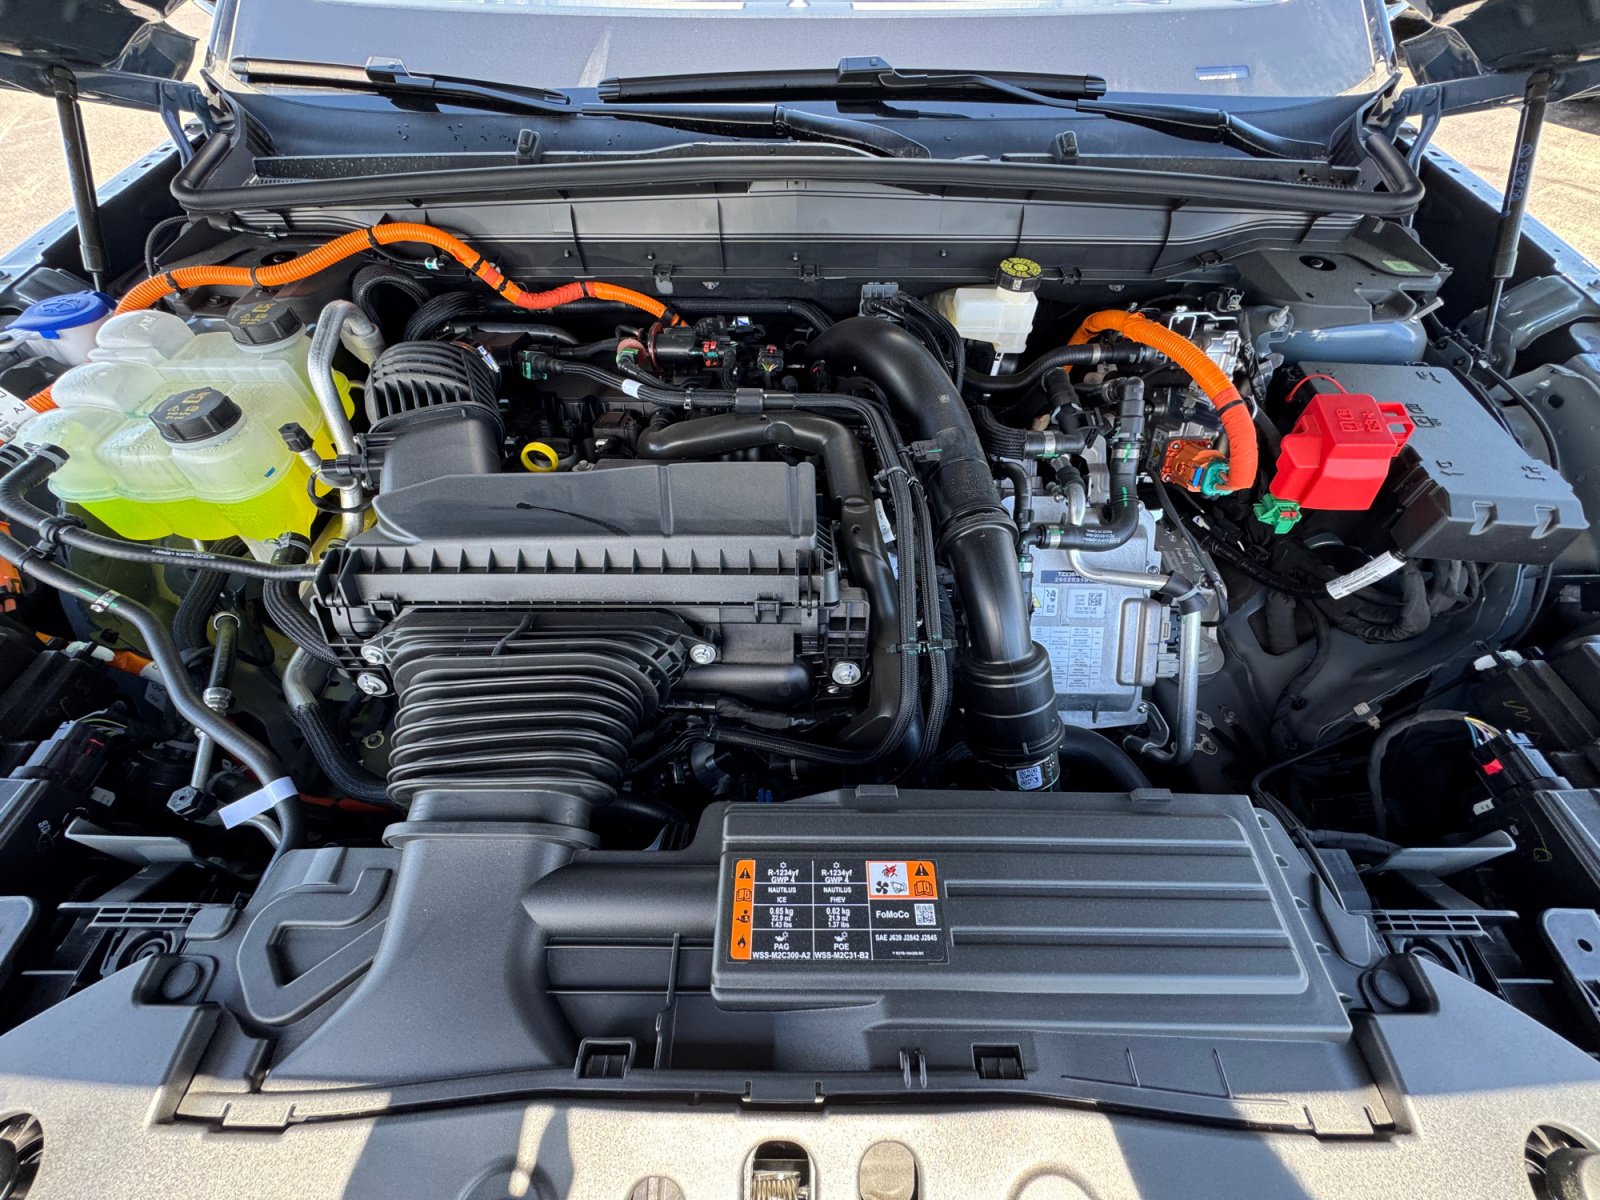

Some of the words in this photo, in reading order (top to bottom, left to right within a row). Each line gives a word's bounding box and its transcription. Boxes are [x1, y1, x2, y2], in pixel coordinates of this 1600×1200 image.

[767, 869, 799, 878] R-1234yf
[821, 869, 853, 878] R-1234yf
[767, 886, 797, 894] NAUTILUS
[823, 886, 852, 894] NAUTILUS
[769, 907, 784, 915] 0.65
[785, 907, 794, 917] kg
[826, 907, 840, 915] 0.62
[842, 907, 851, 917] kg
[876, 910, 910, 919] FoMoCo
[752, 951, 811, 959] WSS-M2C300-A2
[814, 951, 870, 959] WSS-M2C31-B2
